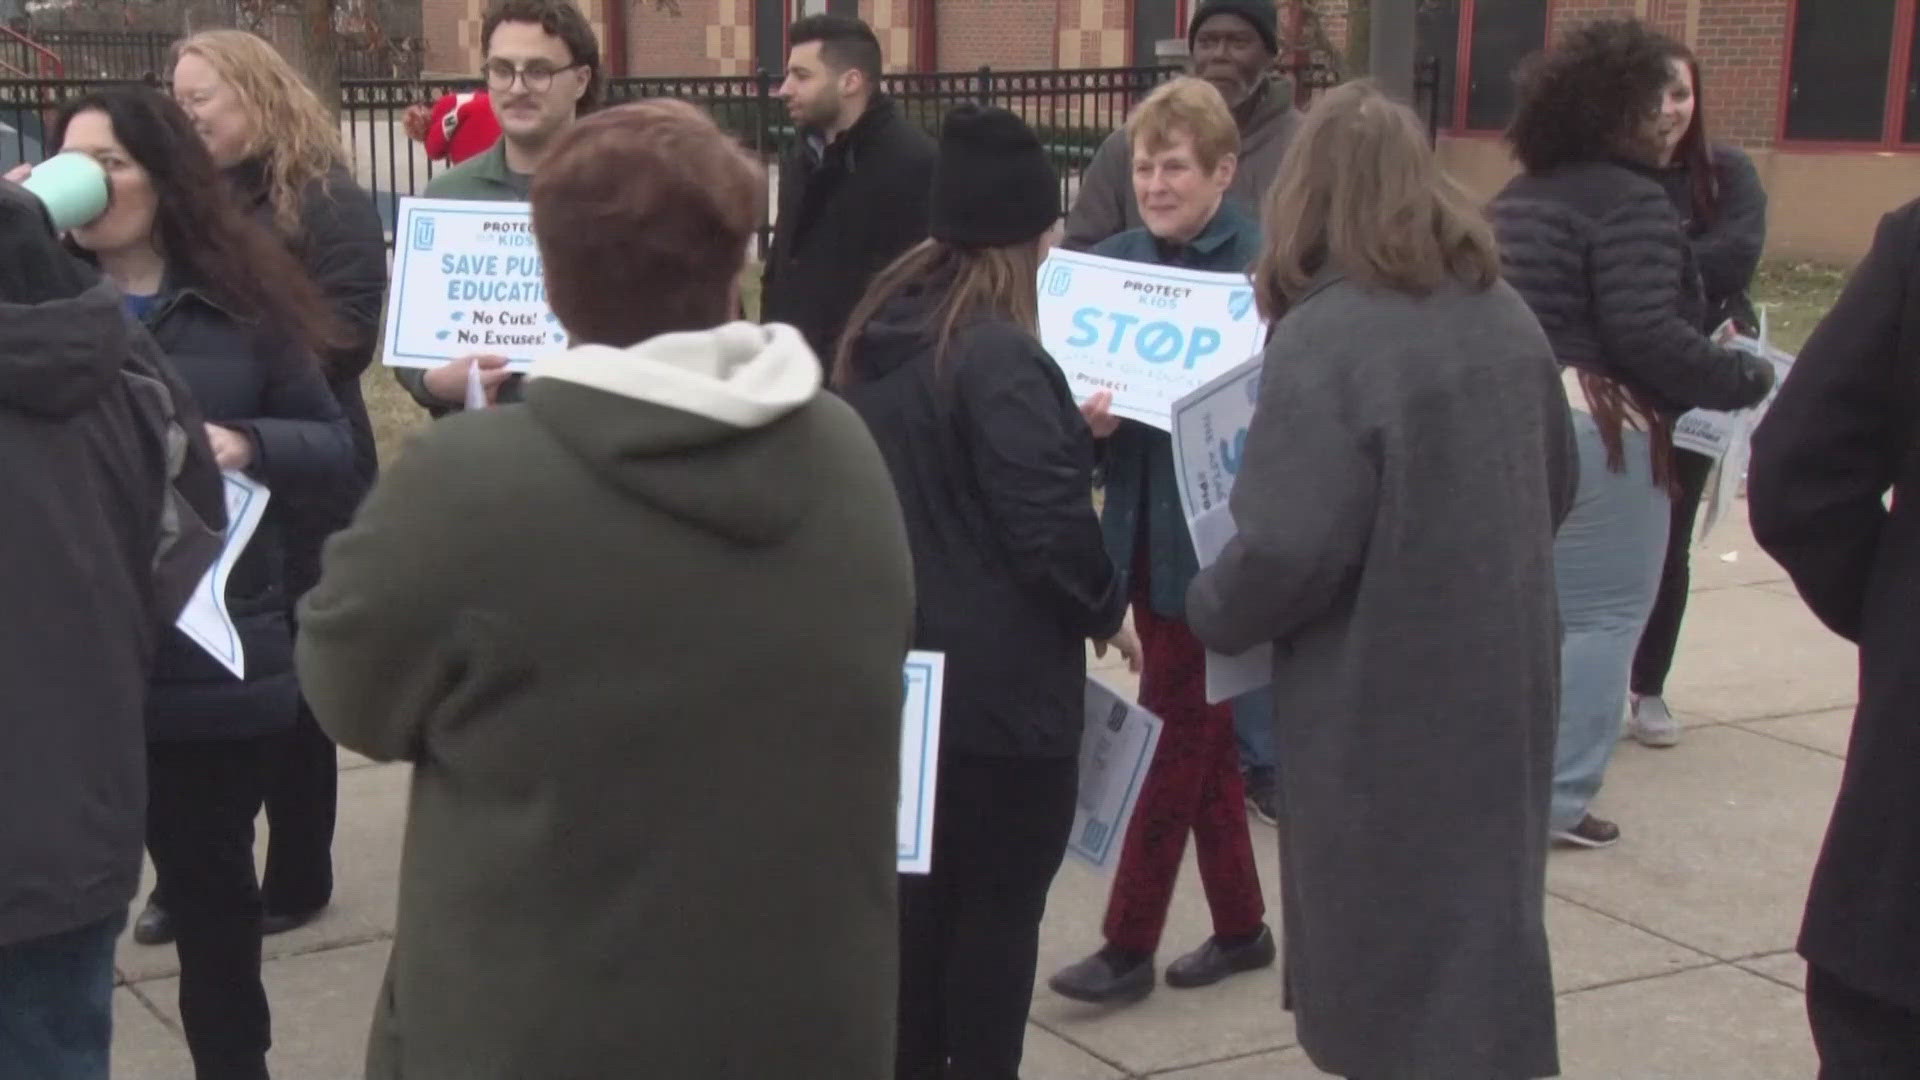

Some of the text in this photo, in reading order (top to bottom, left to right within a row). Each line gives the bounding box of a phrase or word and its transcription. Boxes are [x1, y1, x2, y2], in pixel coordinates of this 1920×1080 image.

[484, 221, 535, 233] PROTEC
[441, 253, 545, 277] SAVE PUB
[1123, 280, 1193, 298] PROTECT
[472, 311, 538, 326] No Cuts!
[457, 329, 547, 345] No Excuses!
[1066, 307, 1221, 370] STOP
